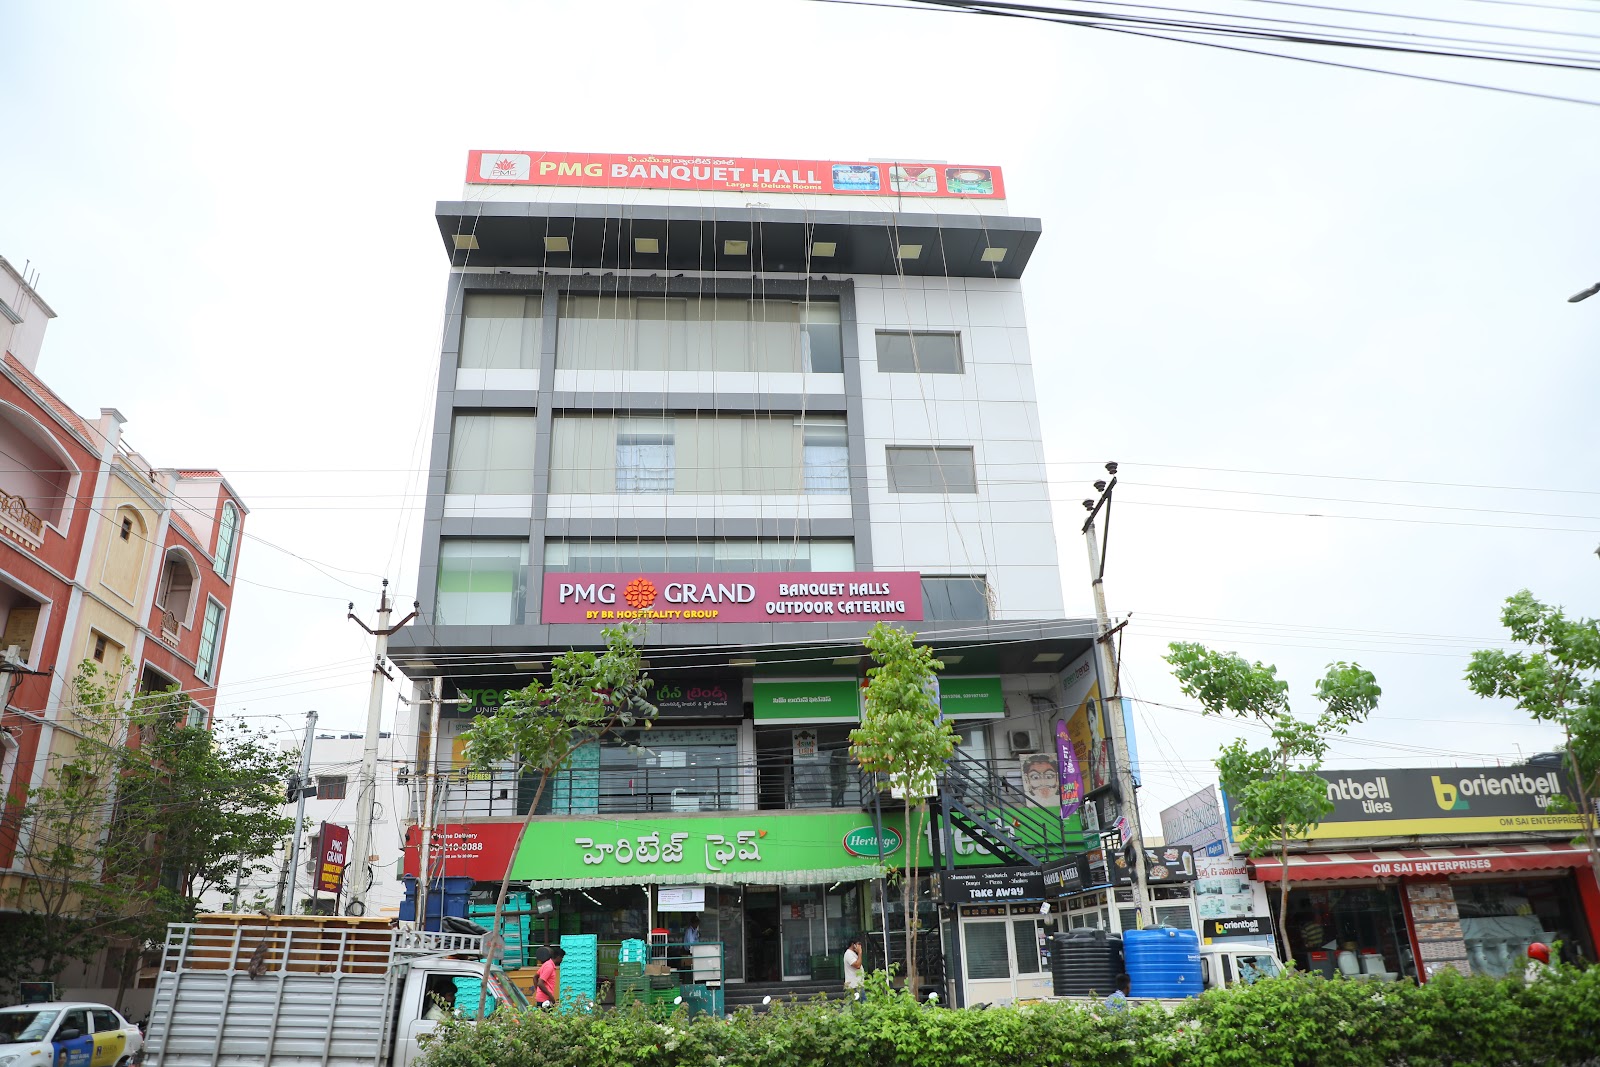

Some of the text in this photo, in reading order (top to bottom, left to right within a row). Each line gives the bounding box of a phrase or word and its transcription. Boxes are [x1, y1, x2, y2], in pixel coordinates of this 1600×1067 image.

[539, 161, 822, 184] PMG BANQUET HALL
[559, 582, 756, 604] PMG GRAND
[779, 582, 890, 597] BANQUET HALLS
[586, 610, 719, 619] BY BR HOSPITALITY GROUP
[765, 600, 905, 615] OUTDOOR CATERING
[657, 685, 682, 700] గ్రీన్
[1326, 777, 1390, 801] ntbell
[1459, 772, 1561, 796] orientbell
[1361, 800, 1393, 814] tiles
[1534, 795, 1560, 808] tile
[1500, 816, 1587, 826] OM SAI ENTERPRISES
[331, 839, 343, 852] PMG
[417, 842, 483, 852] 10-210-0088
[850, 835, 896, 848] Heritge
[326, 851, 344, 864] GRAND
[575, 831, 762, 871] హెరిటేజ్ ఫ్రెష్
[1211, 867, 1218, 875] &
[1372, 859, 1491, 873] OM SAI ENTERPRISES
[1224, 920, 1259, 929] orientbell
